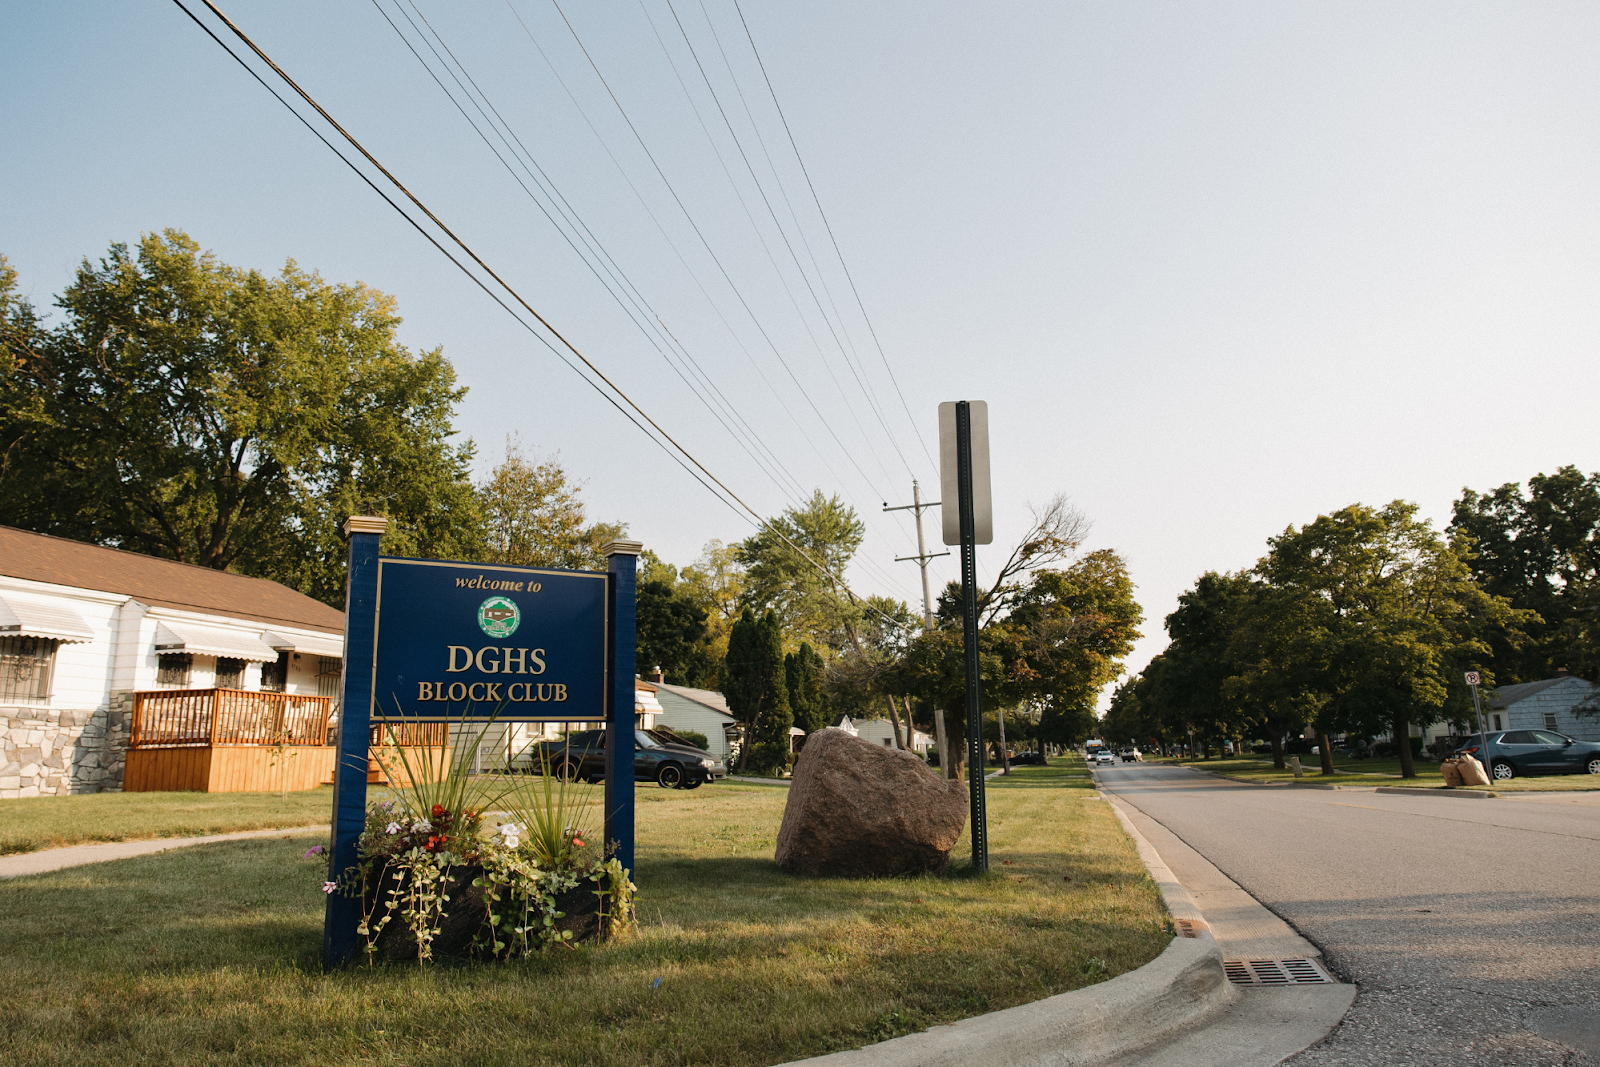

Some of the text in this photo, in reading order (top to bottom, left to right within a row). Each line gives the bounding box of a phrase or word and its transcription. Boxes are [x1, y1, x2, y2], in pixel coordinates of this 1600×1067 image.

[455, 575, 542, 593] welcome to
[445, 645, 547, 675] DGHS
[417, 681, 568, 702] BLOCK CLUB
